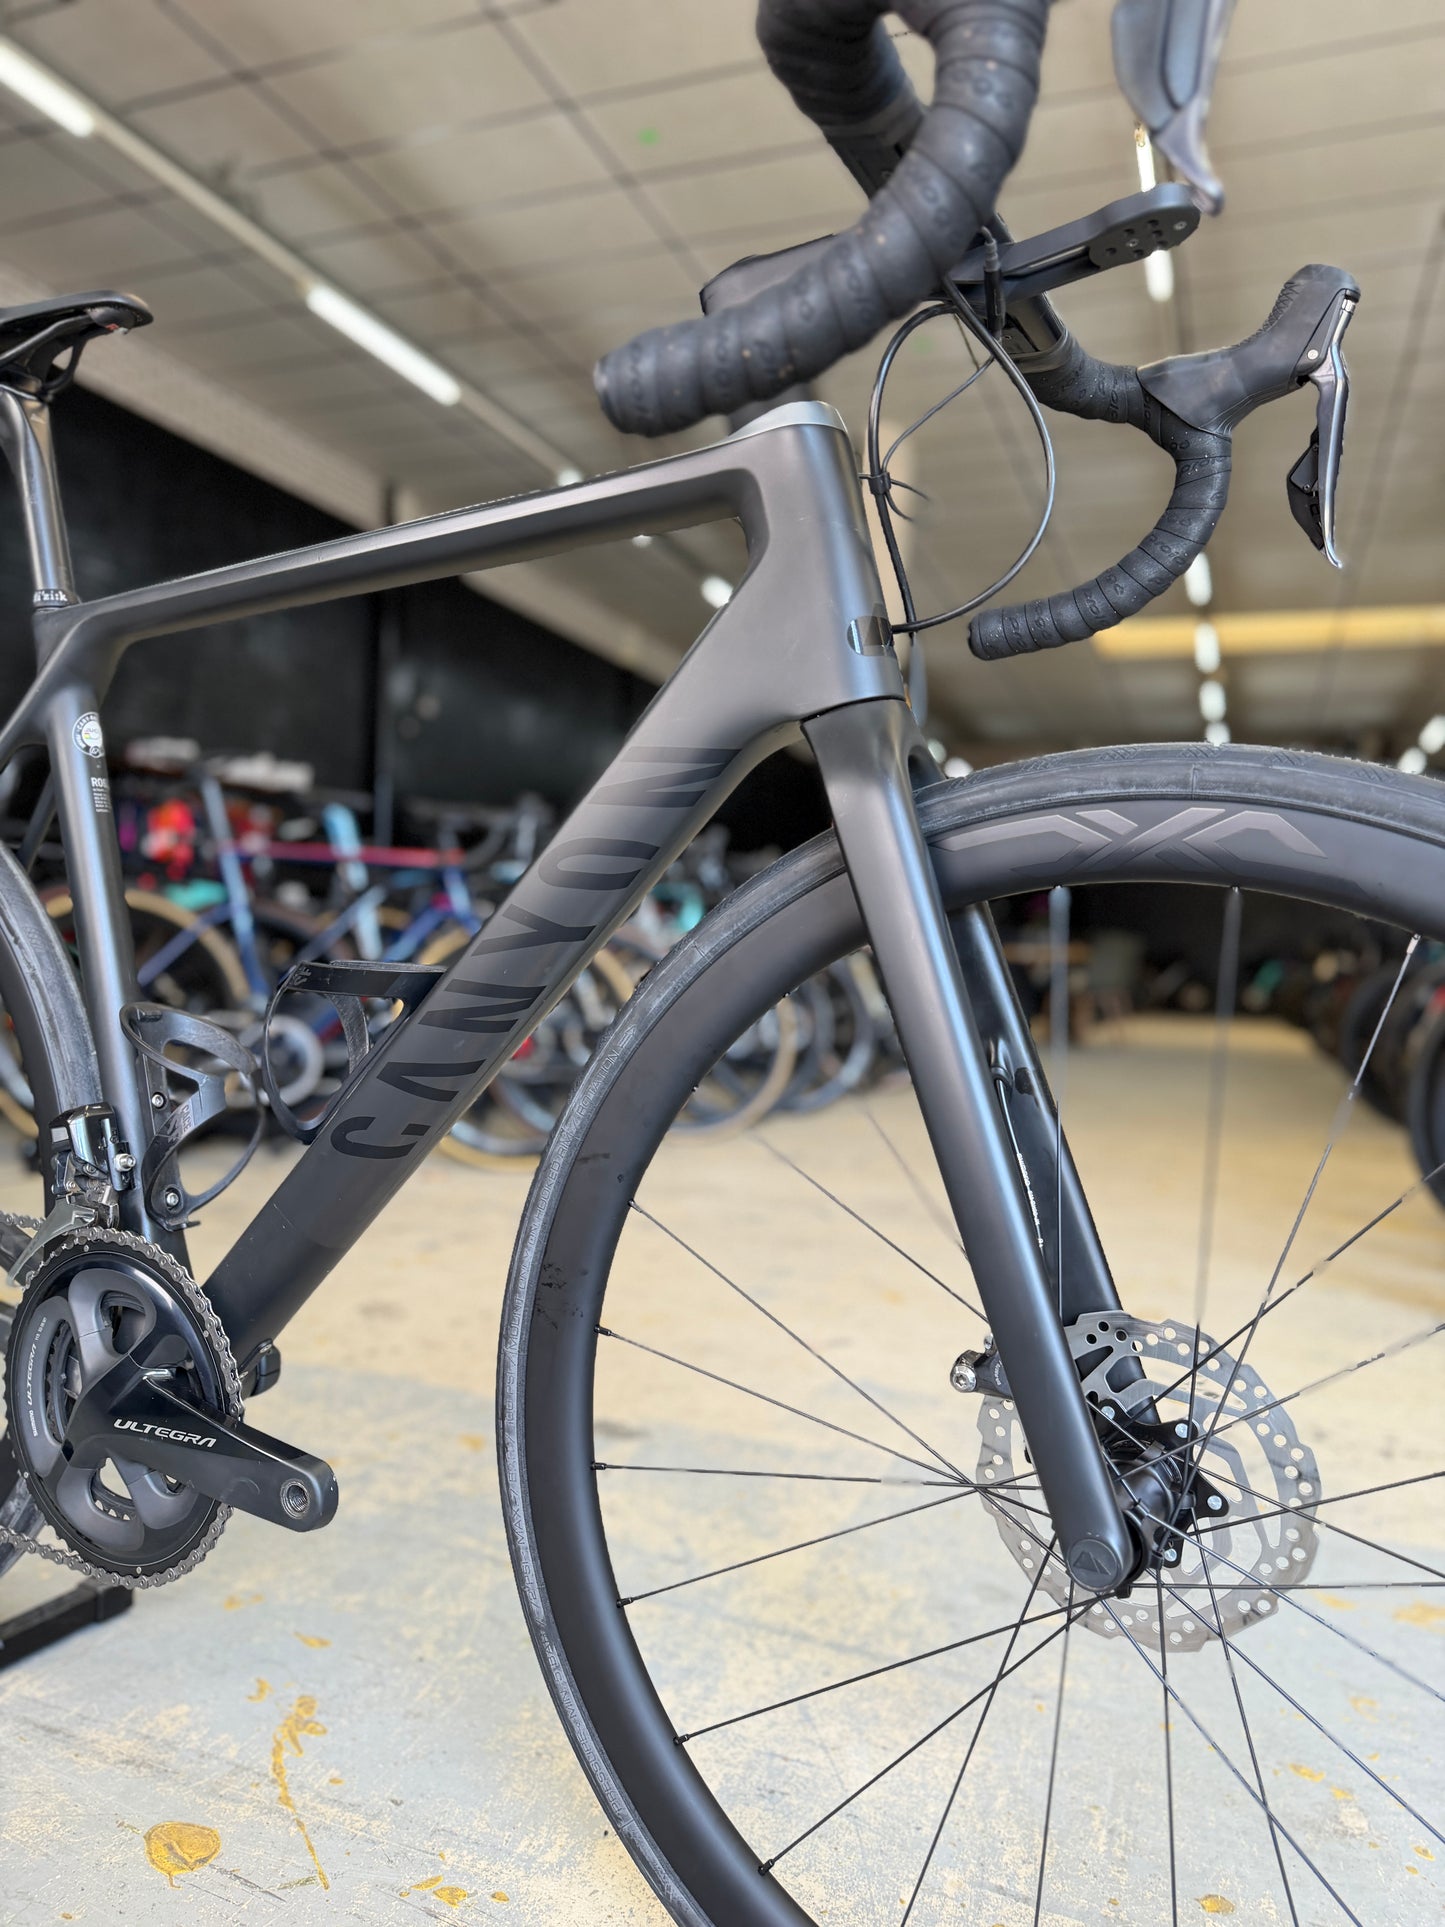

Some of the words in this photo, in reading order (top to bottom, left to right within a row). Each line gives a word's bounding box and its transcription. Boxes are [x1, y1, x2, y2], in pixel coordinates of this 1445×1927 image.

[330, 744, 744, 1160] CANYON
[533, 1160, 562, 1220] HOOKED
[575, 1048, 620, 1117] ROTATION
[27, 1343, 37, 1406] ULTEGRA
[113, 1418, 217, 1448] ULTEGRA
